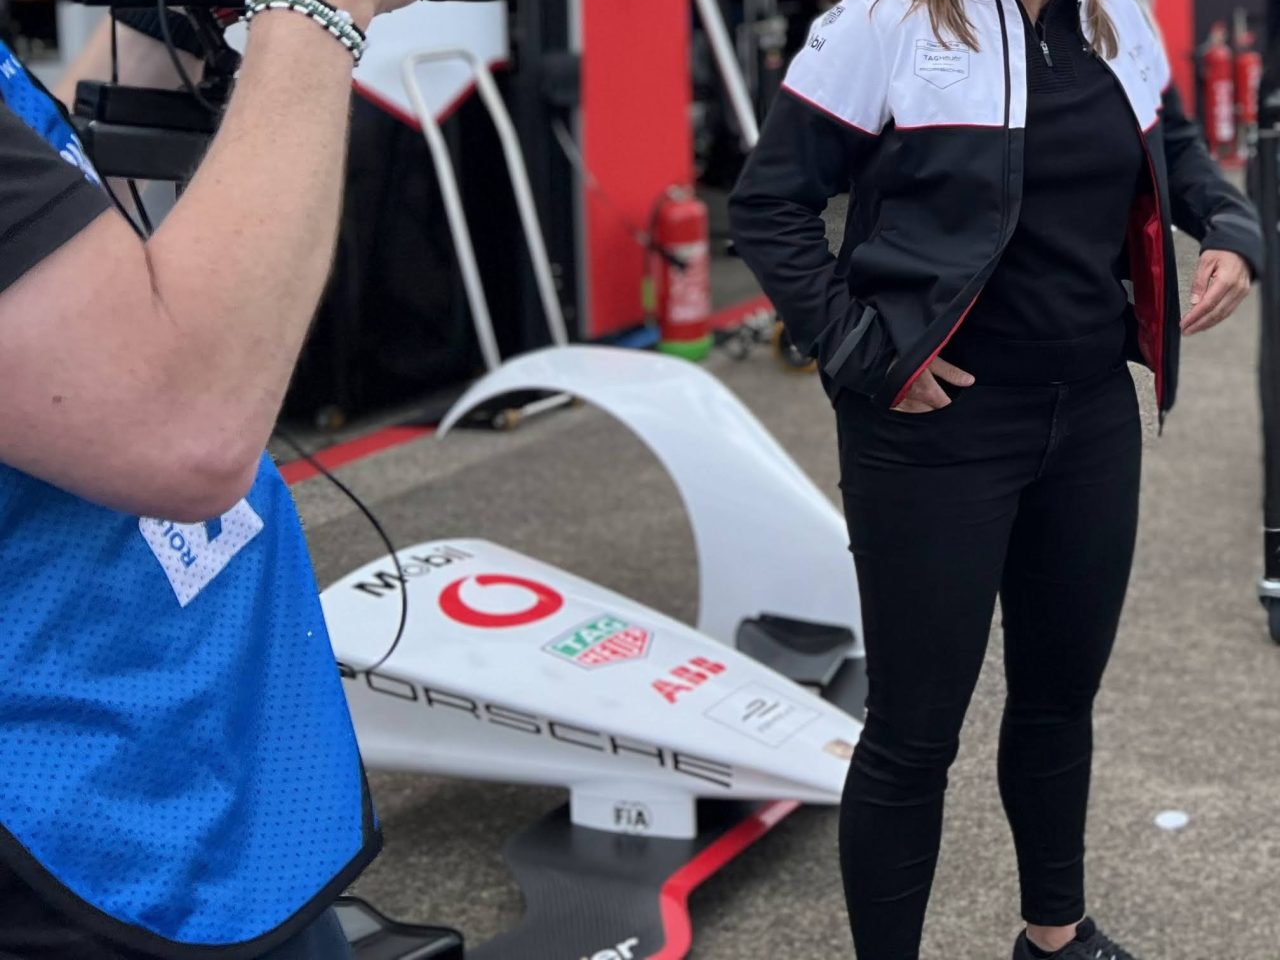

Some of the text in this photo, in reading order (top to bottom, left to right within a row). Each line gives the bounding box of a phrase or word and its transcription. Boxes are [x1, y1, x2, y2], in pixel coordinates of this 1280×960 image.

[553, 616, 627, 652] TAG
[576, 626, 649, 667] HEUER
[651, 656, 728, 705] ABB
